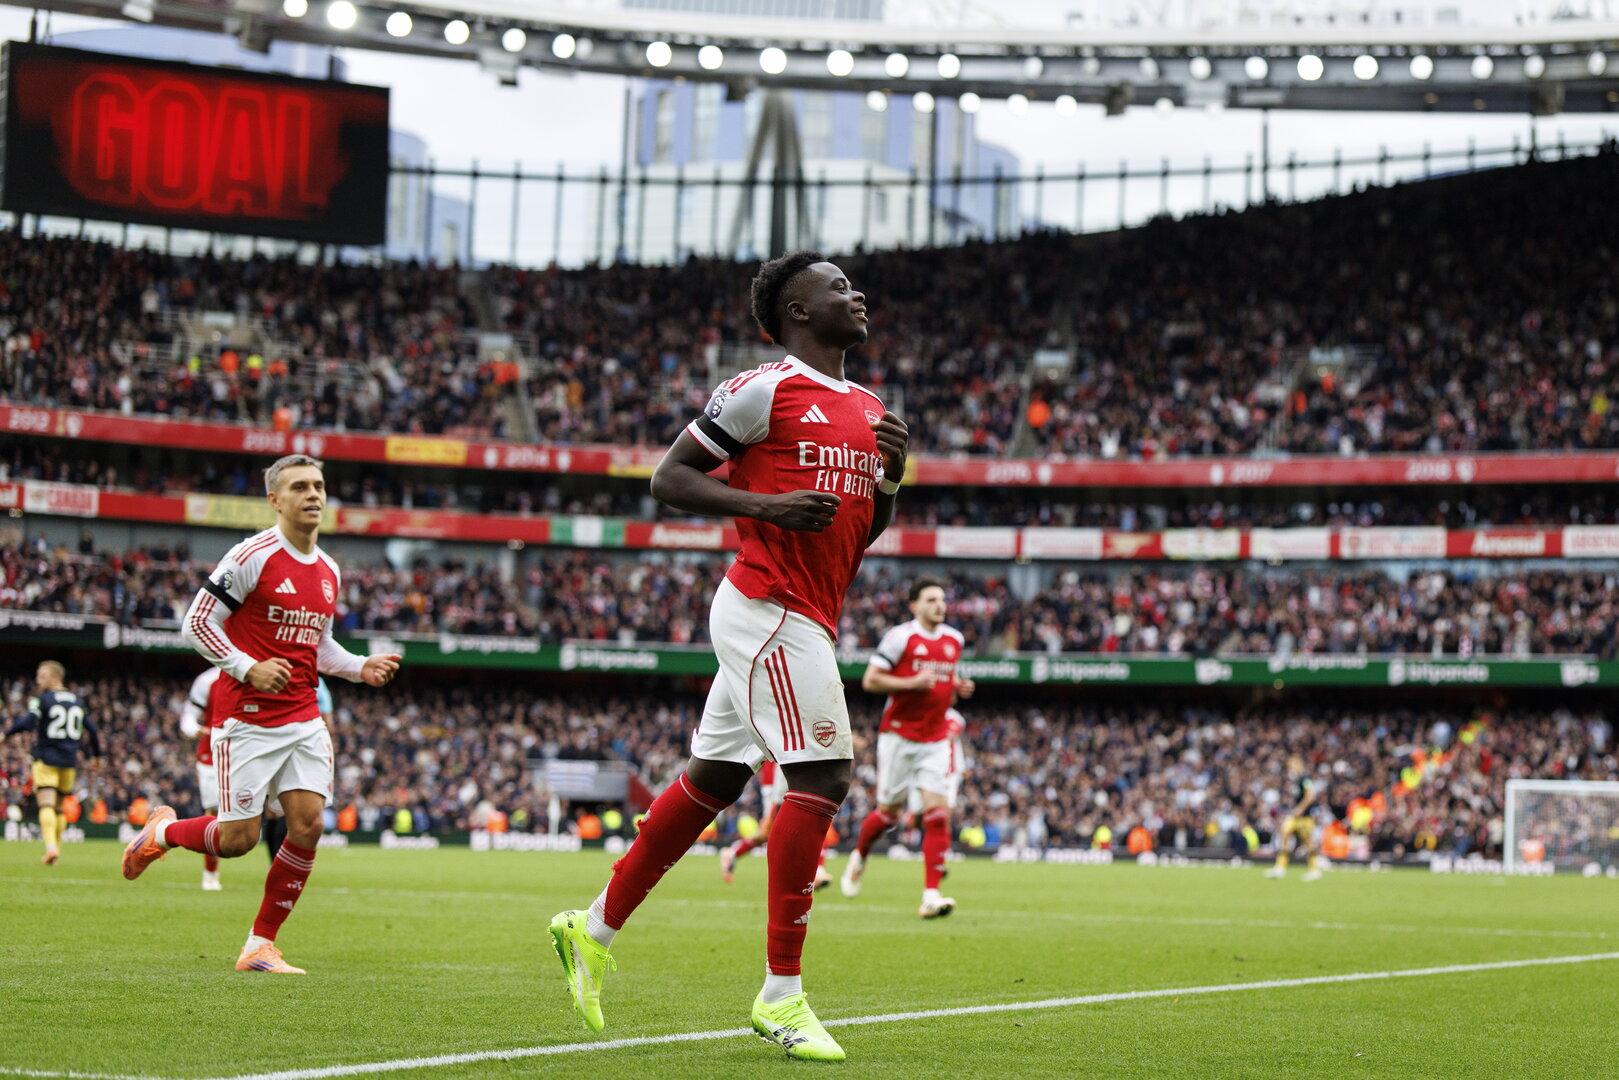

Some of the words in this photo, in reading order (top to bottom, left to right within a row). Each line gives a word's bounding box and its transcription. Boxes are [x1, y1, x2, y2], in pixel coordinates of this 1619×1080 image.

[70, 71, 329, 218] GOAL
[798, 441, 876, 475] Emirat
[815, 470, 838, 491] FLY
[268, 605, 326, 630] Emirat
[275, 626, 297, 642] FLY
[46, 704, 84, 740] 20
